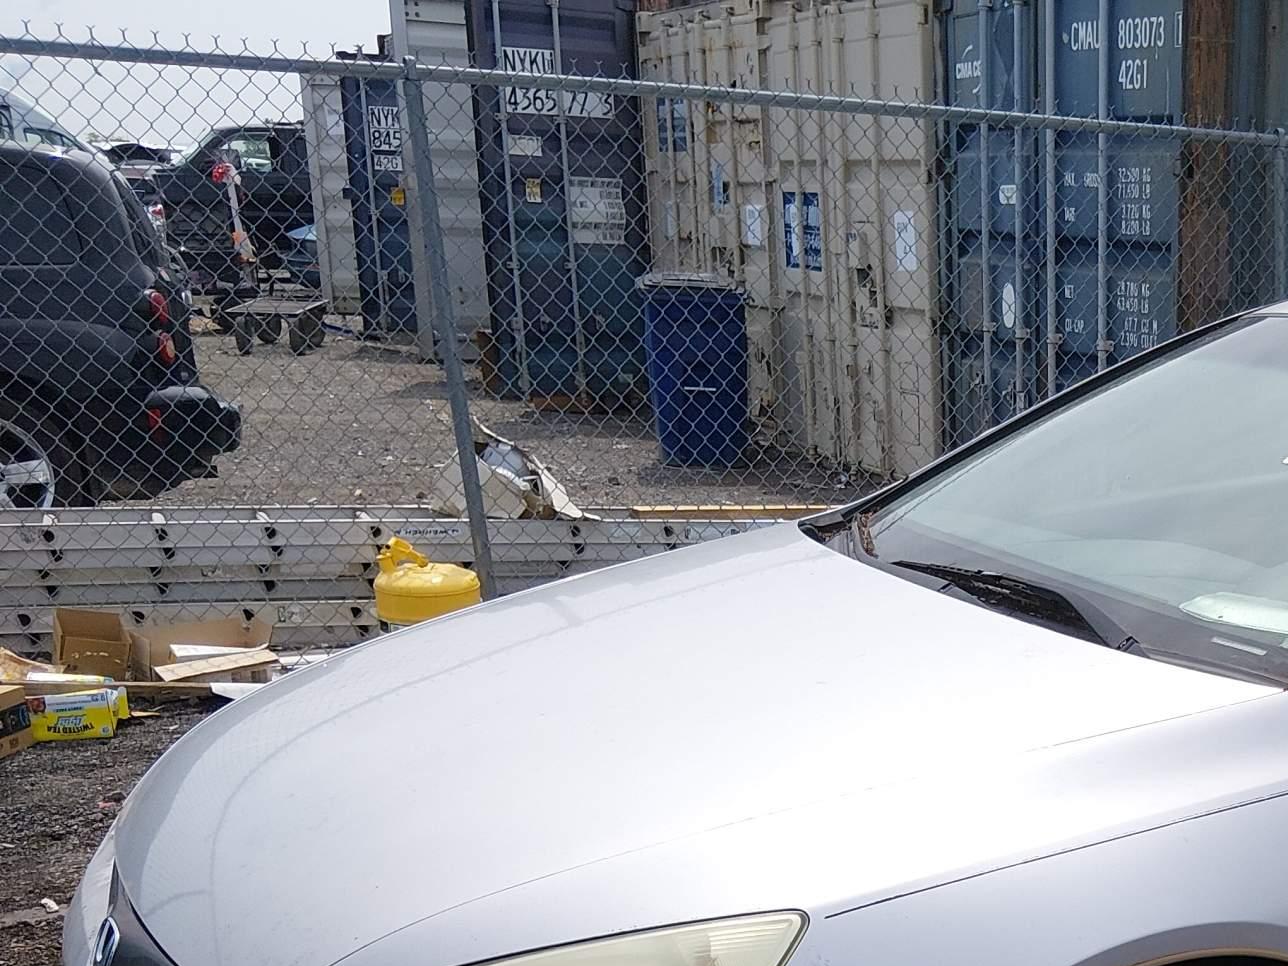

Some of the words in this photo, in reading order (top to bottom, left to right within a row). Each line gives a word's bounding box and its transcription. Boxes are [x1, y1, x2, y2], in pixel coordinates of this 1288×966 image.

[1071, 20, 1100, 50] CMAU
[1118, 16, 1165, 49] 803073
[1118, 59, 1148, 90] 42G1
